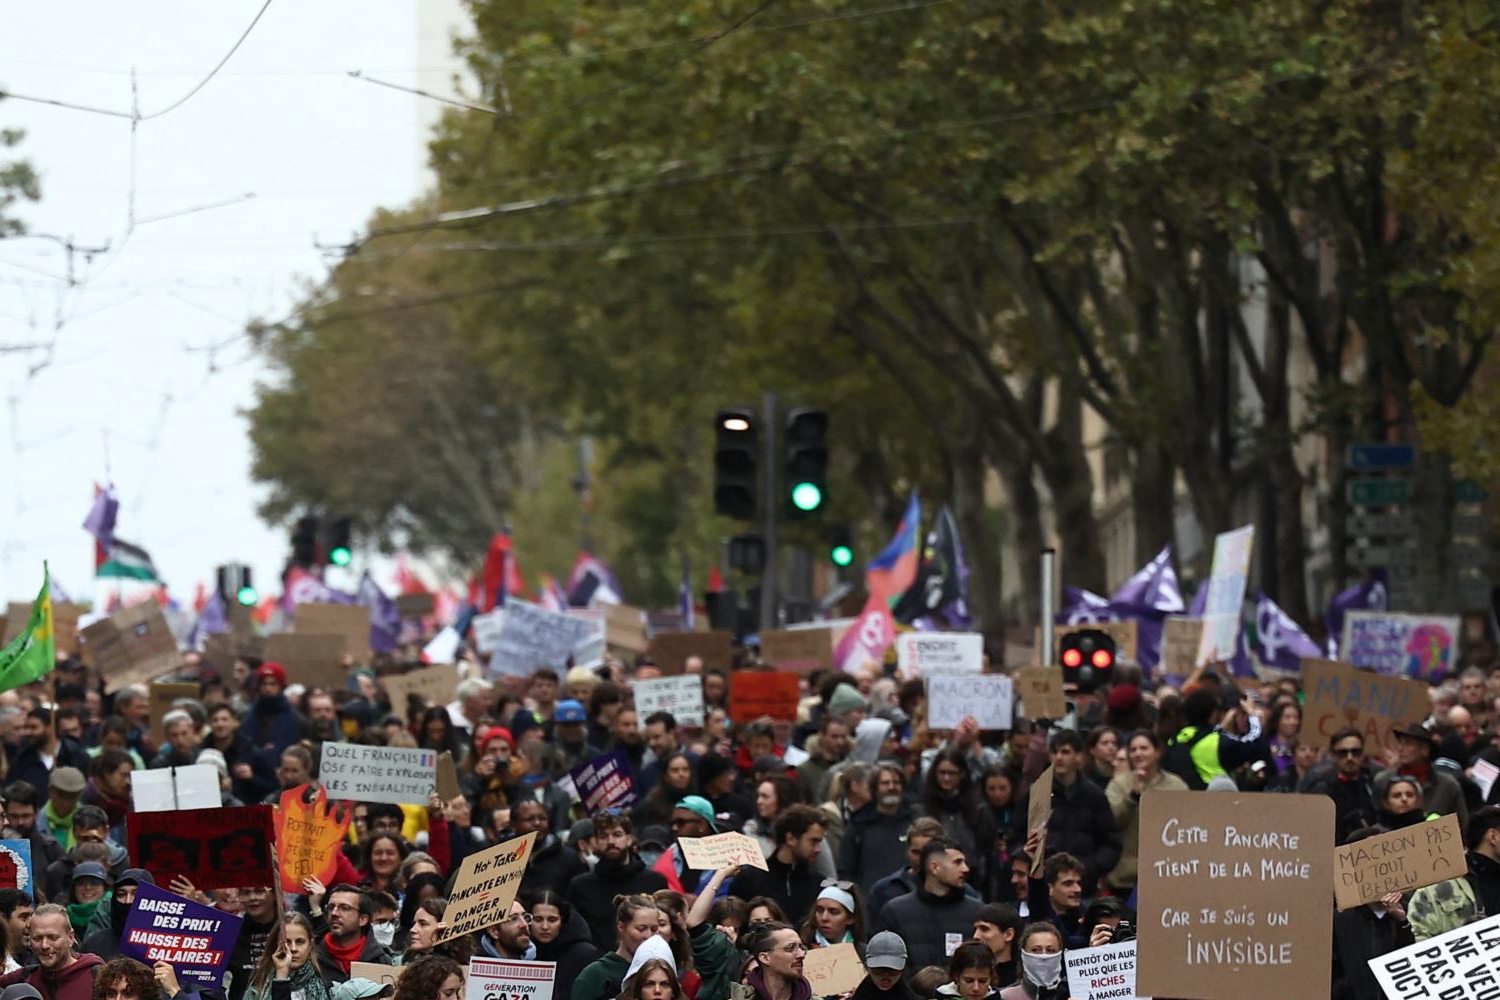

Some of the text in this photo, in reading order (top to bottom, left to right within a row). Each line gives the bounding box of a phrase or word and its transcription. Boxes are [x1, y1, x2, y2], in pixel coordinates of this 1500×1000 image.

[326, 746, 419, 764] QUEL FRANÇAIS
[322, 762, 346, 773] OSE
[351, 765, 383, 777] FAIRE
[326, 780, 348, 791] LES
[288, 817, 325, 836] PORTRAIT
[1224, 826, 1299, 849] PANCARTE
[1340, 826, 1452, 869] MACRON PAS
[474, 852, 518, 875] Hot Take
[1209, 862, 1227, 879] DE
[1234, 862, 1252, 878] LA
[1342, 856, 1405, 887] DU TOUT
[449, 879, 494, 905] PANCARTE
[495, 874, 507, 887] EN
[138, 899, 186, 916] BAISSE
[454, 897, 500, 922] DANGER
[153, 915, 221, 932] DES PRIX !
[1161, 908, 1190, 928] CAR
[1200, 908, 1217, 924] JE
[1267, 911, 1289, 926] UN
[129, 930, 209, 950] HAUSSE DES
[1444, 935, 1480, 964] NE
[147, 947, 220, 965] SALAIRES !
[1068, 949, 1136, 968] BIENTÔT ON AUR
[1414, 946, 1456, 985] PAS
[1079, 961, 1134, 978] PLUS QUE LES
[1091, 975, 1126, 989] RICHES
[1096, 988, 1132, 1000] MANGER
